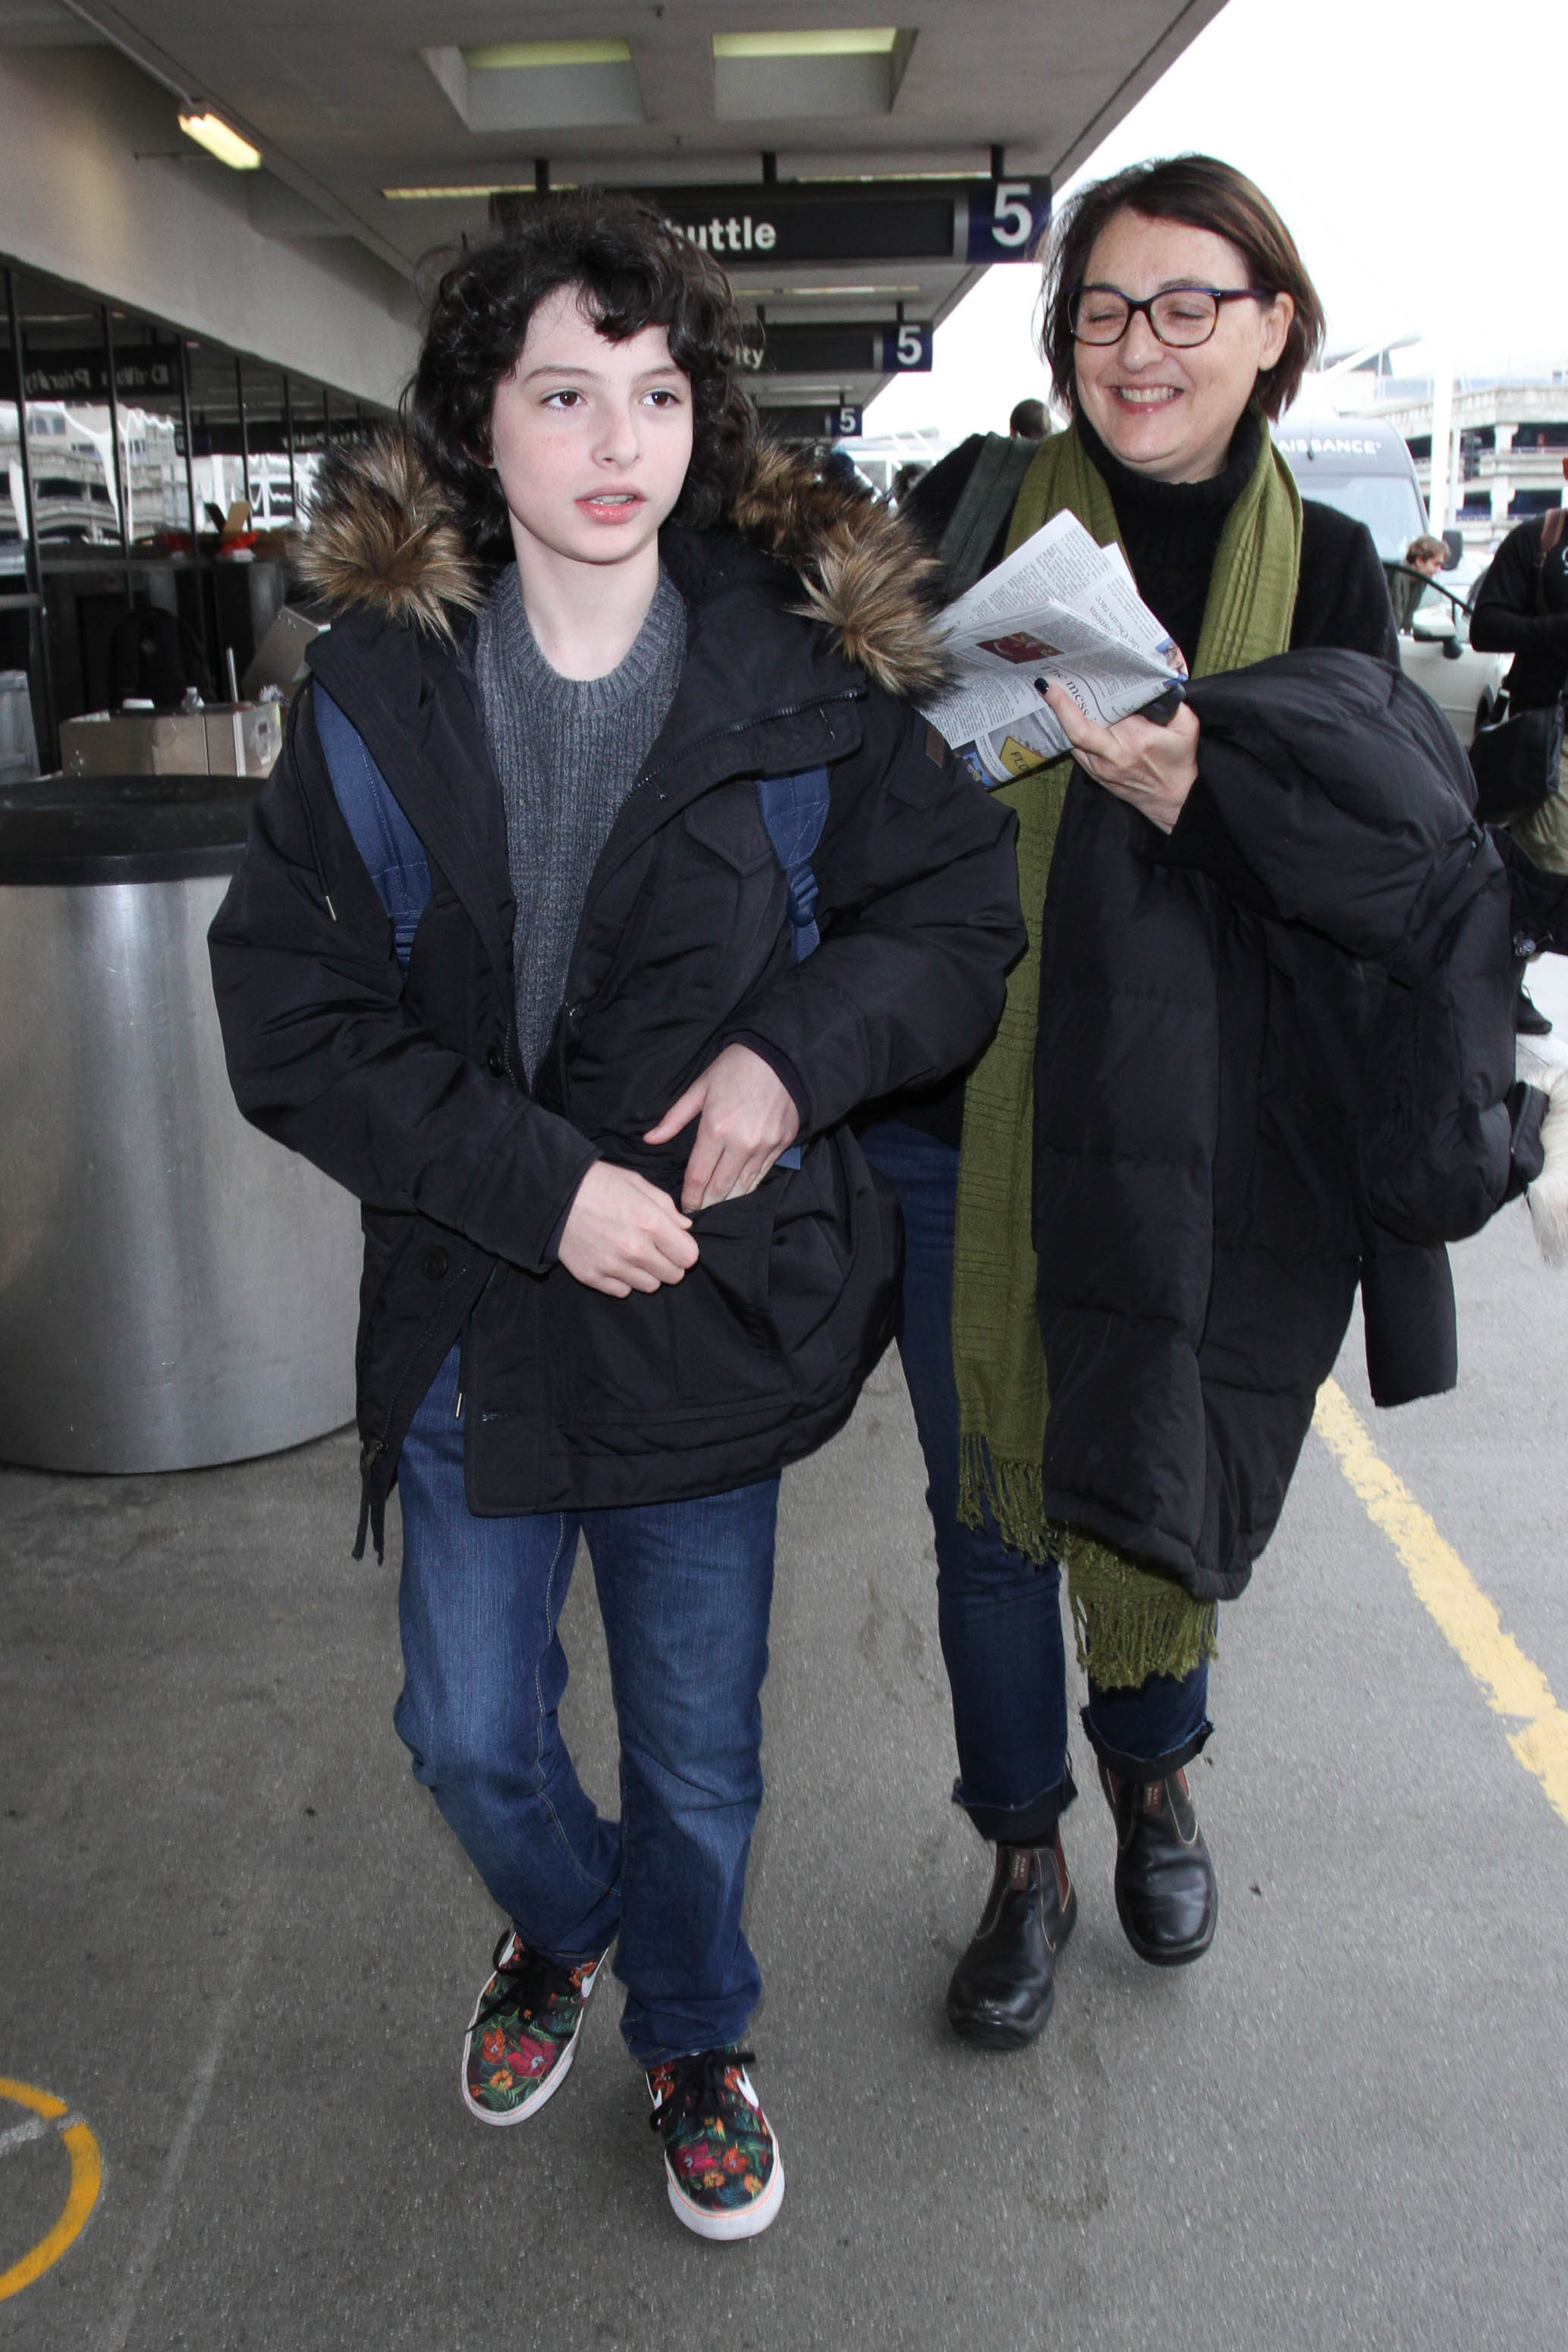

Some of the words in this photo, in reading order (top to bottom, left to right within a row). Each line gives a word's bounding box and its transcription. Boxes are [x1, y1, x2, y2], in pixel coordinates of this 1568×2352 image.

[991, 183, 1033, 247] 5
[897, 325, 922, 366] 5
[839, 407, 856, 433] 5
